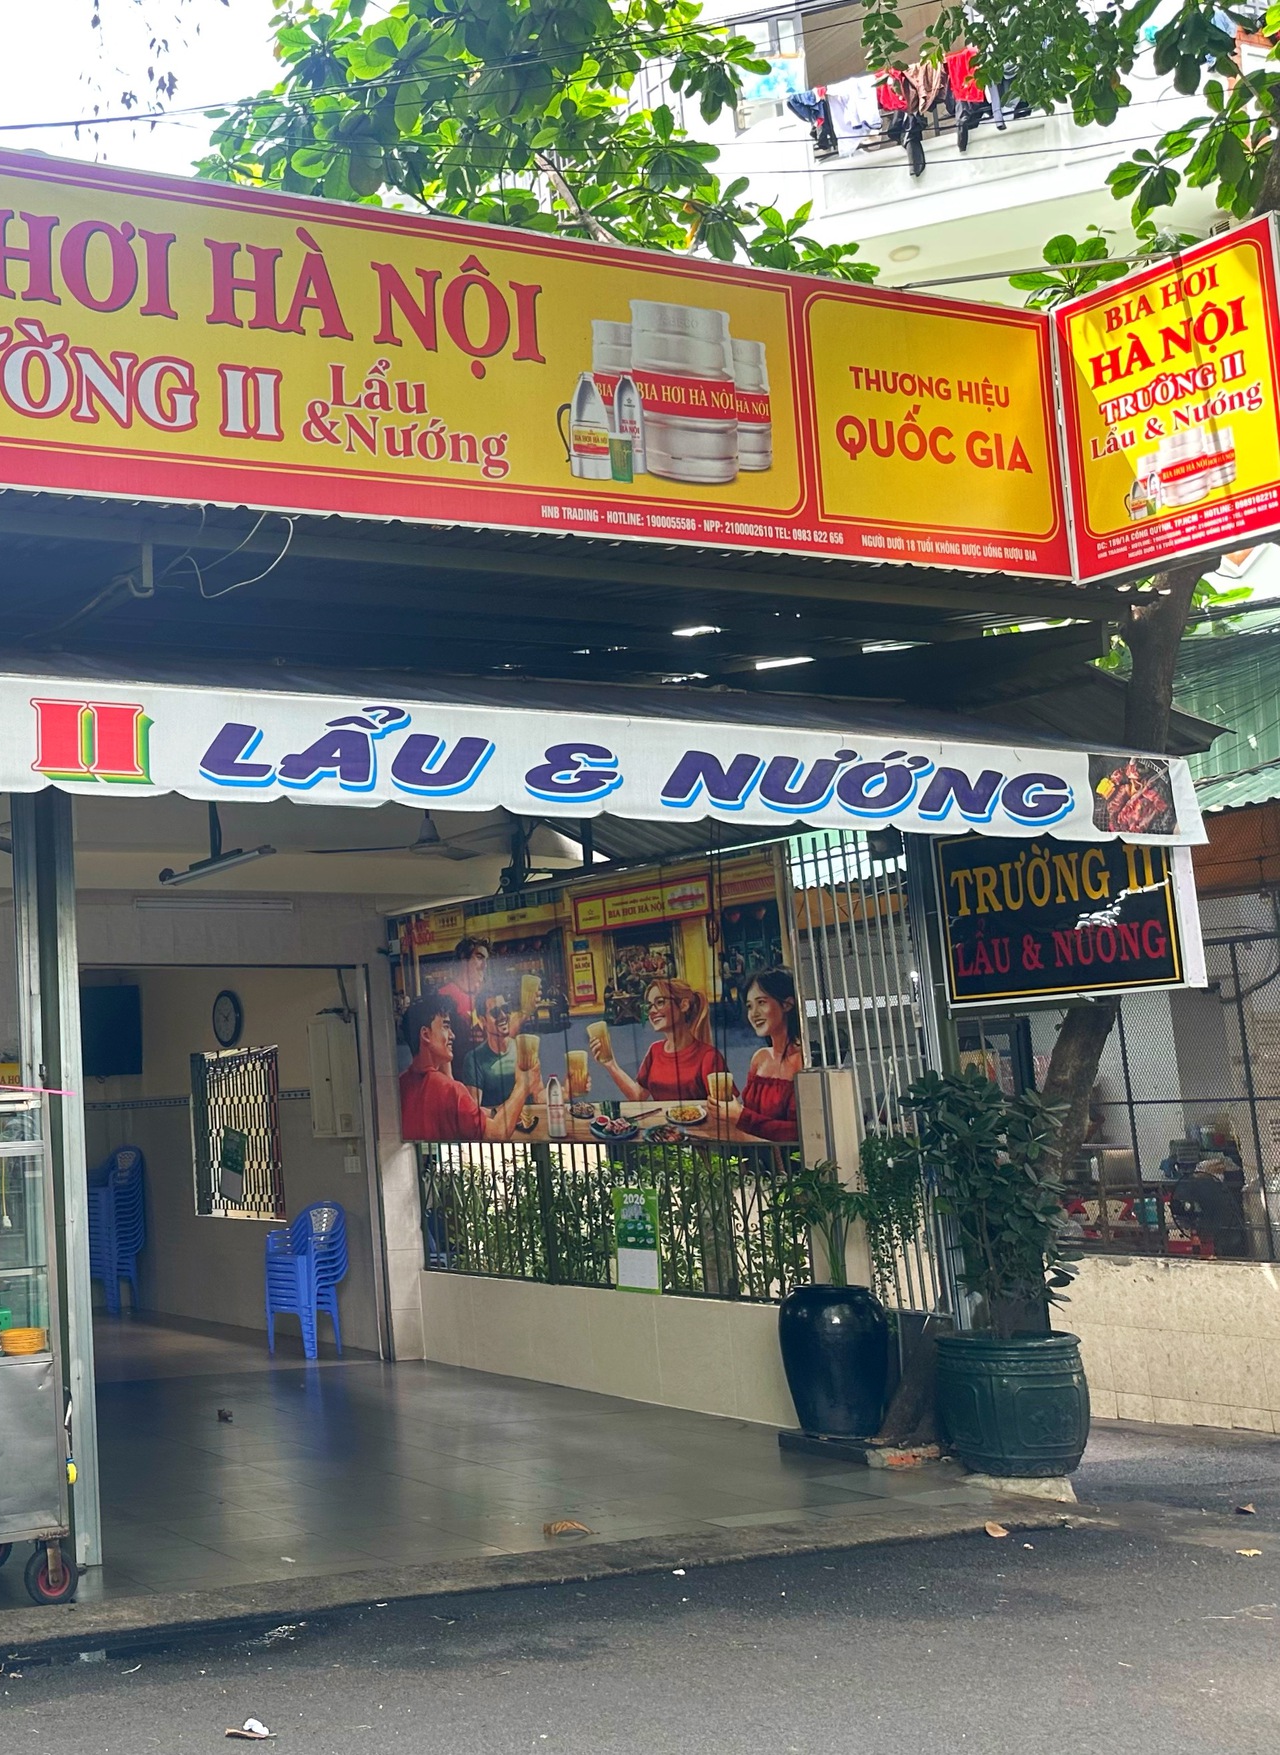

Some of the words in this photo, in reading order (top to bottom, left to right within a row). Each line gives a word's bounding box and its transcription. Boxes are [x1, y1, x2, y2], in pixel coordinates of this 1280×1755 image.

[204, 227, 354, 342] HÀ
[371, 254, 546, 379] NỘI
[1104, 294, 1155, 334] BIA
[1160, 264, 1219, 310] HƠI
[1088, 331, 1155, 390] HÀ
[1158, 296, 1248, 362] NỘI
[219, 363, 284, 443] II
[329, 356, 430, 417] Lẩu
[637, 383, 658, 401] BIA
[661, 385, 686, 404] HƠI
[689, 386, 708, 408] HÀ
[710, 391, 735, 414] NỘI
[848, 365, 952, 401] THƯƠNG
[957, 377, 1011, 411] HIỆU
[1090, 426, 1136, 460] Lẩu
[1144, 416, 1165, 440] &
[1173, 381, 1263, 431] Nướng
[1099, 361, 1217, 426] TRƯỜNG
[1220, 350, 1246, 383] II
[835, 403, 955, 464] QUỐC
[964, 429, 1034, 475] GIA
[541, 505, 560, 519] HNB
[561, 506, 599, 523] TRADING
[606, 510, 644, 527] HOTLINE:
[646, 514, 696, 531] 1900055586
[703, 518, 723, 533] NPP:
[725, 522, 772, 538] 2100002610
[774, 527, 791, 540] TEL:
[792, 528, 812, 542] 0983
[813, 530, 826, 543] 622
[827, 531, 844, 545] 656
[906, 539, 915, 551] 18
[935, 541, 960, 555] KHÔNG
[1024, 549, 1037, 562] BIA
[29, 696, 154, 785] II
[198, 705, 495, 797] LẨU
[524, 741, 623, 801] &
[660, 746, 1074, 826] NƯỚNG
[950, 843, 1110, 916] TRƯỜNG
[1122, 845, 1159, 894] II
[1022, 933, 1044, 971] &
[622, 1193, 646, 1205] 2026
